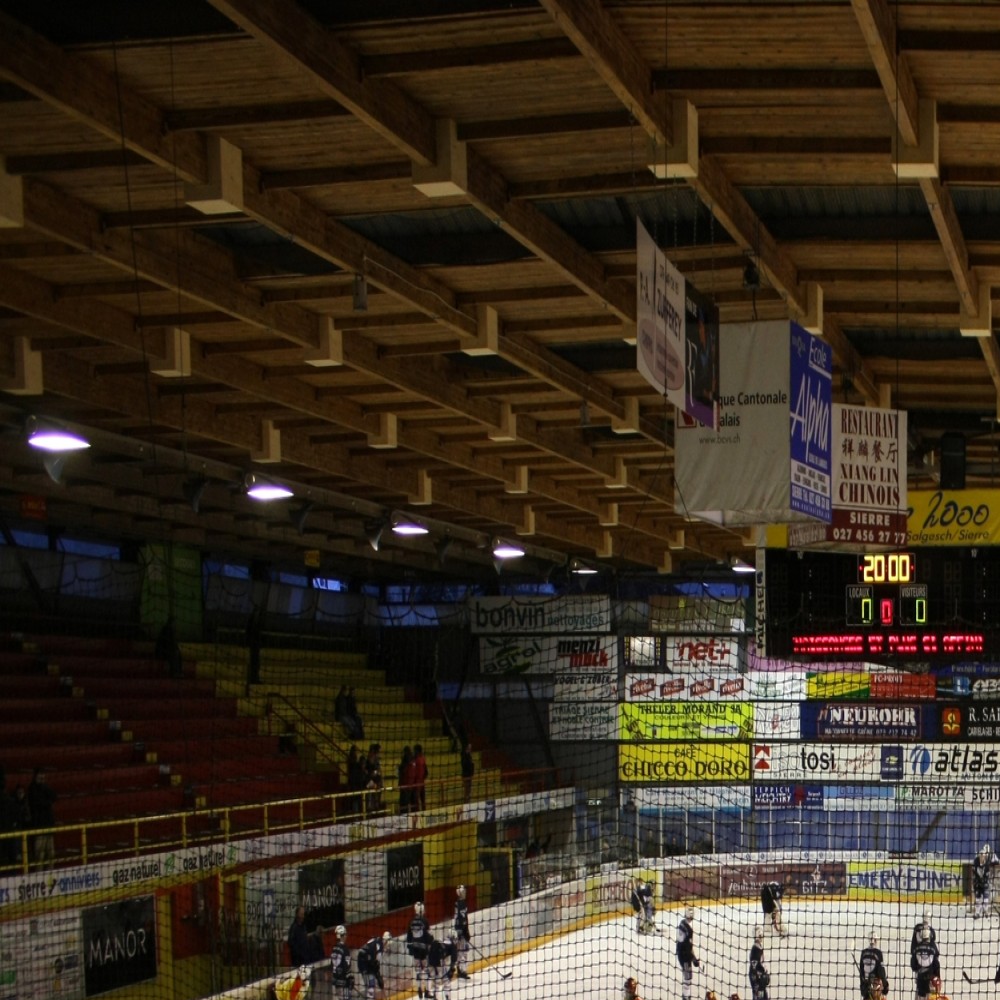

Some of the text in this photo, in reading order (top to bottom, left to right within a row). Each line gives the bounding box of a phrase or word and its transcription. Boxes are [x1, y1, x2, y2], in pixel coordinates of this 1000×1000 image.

[737, 390, 787, 405] Cantonale
[719, 412, 740, 427] alais
[790, 372, 829, 462] Alpha
[841, 408, 898, 439] RESTAURANT
[840, 463, 877, 481] XIANG
[880, 467, 899, 483] LIN
[839, 481, 899, 506] CHINOIS
[850, 511, 891, 527] SIERRE
[833, 528, 852, 540] 027
[856, 529, 875, 541] 456
[878, 531, 891, 542] 27
[849, 588, 870, 598] LOCAUX
[901, 587, 927, 598] VISITEURS
[475, 602, 545, 627] bonvin
[861, 598, 872, 624] 0
[881, 600, 892, 624] 0
[916, 599, 926, 623] 0
[968, 707, 979, 721] R.
[622, 761, 688, 777] CHICCO
[934, 745, 998, 772] atlas
[912, 786, 965, 797] MAROTTA
[389, 865, 420, 888] MANOR
[18, 879, 46, 900] sierre
[89, 928, 148, 969] MANOR
